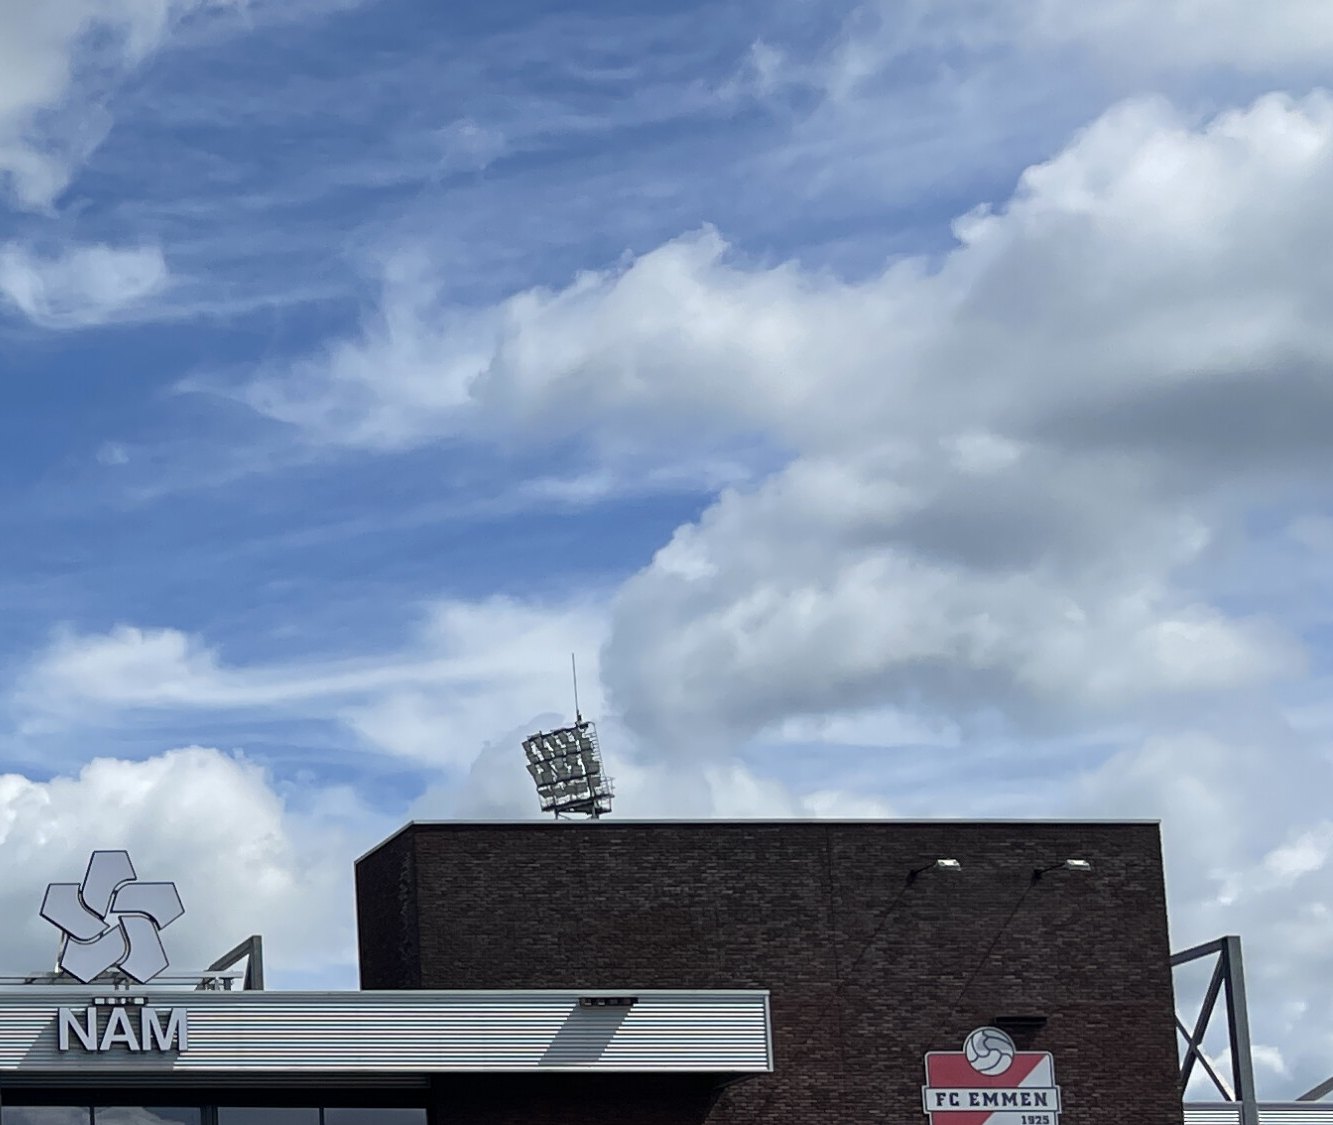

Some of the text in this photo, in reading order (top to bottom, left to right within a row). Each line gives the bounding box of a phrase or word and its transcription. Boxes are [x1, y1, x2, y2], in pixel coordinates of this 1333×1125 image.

[58, 1006, 189, 1051] NAM
[935, 1092, 1049, 1107] FC EMMEN
[1021, 1115, 1050, 1125] 1925
